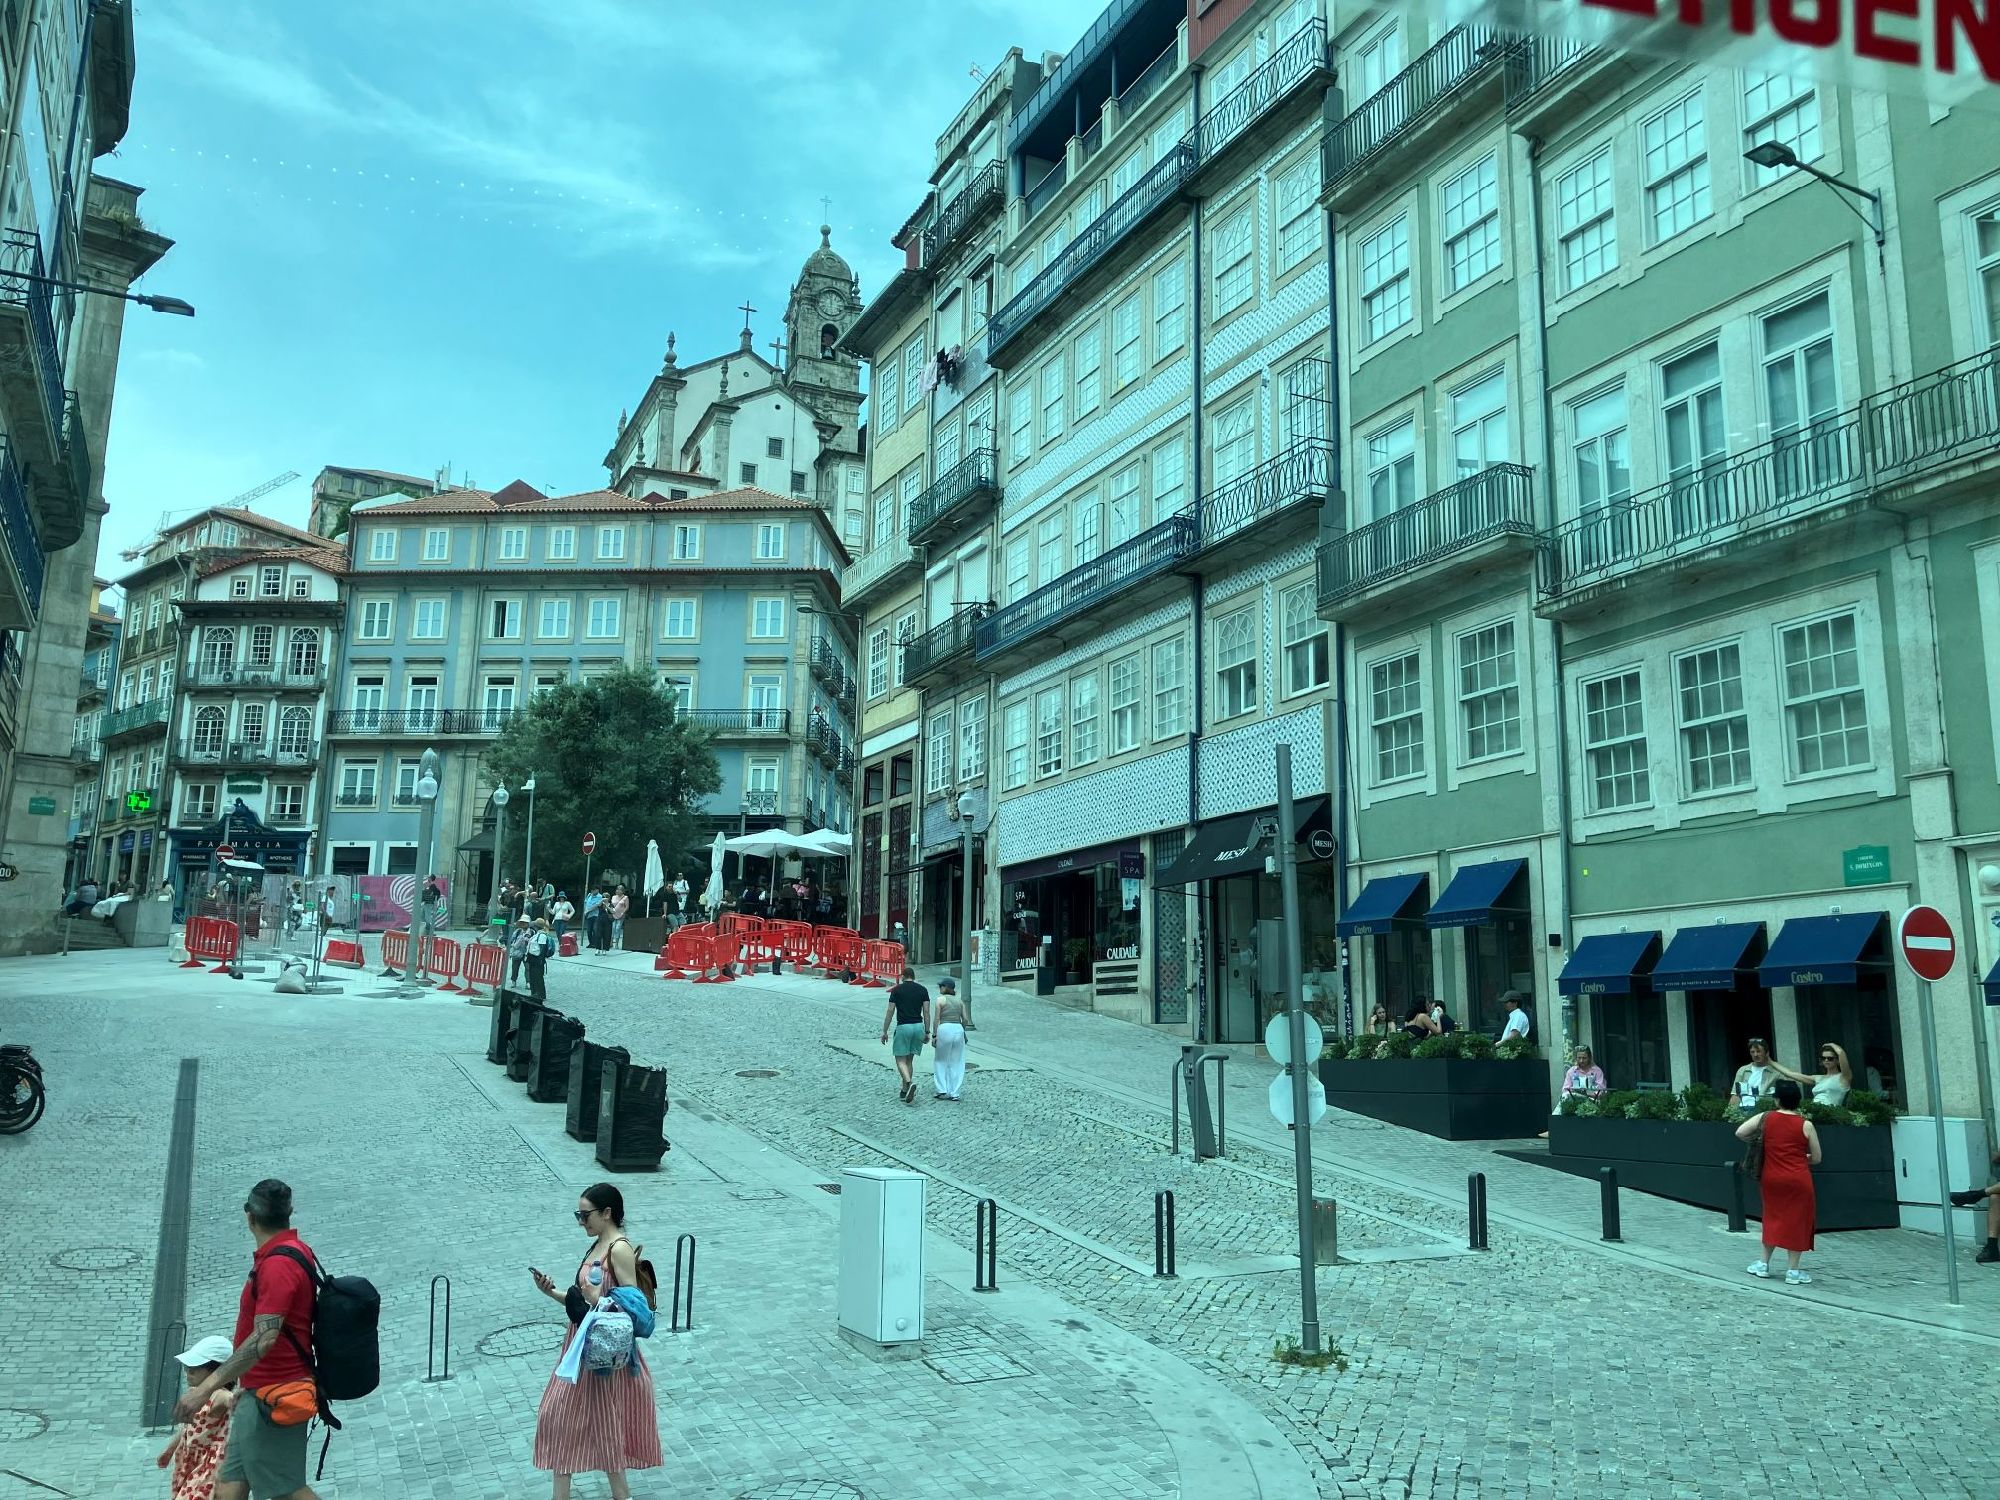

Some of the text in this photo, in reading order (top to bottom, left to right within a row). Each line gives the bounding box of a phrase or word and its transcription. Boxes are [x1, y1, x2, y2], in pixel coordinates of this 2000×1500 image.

[1314, 839, 1333, 849] MESH
[1213, 846, 1249, 862] MESH
[1124, 866, 1140, 874] SPA
[1855, 861, 1884, 870] DOMINGOS
[1015, 891, 1026, 901] SPA
[1790, 971, 1823, 984] Castro
[1580, 982, 1606, 993] Castro
